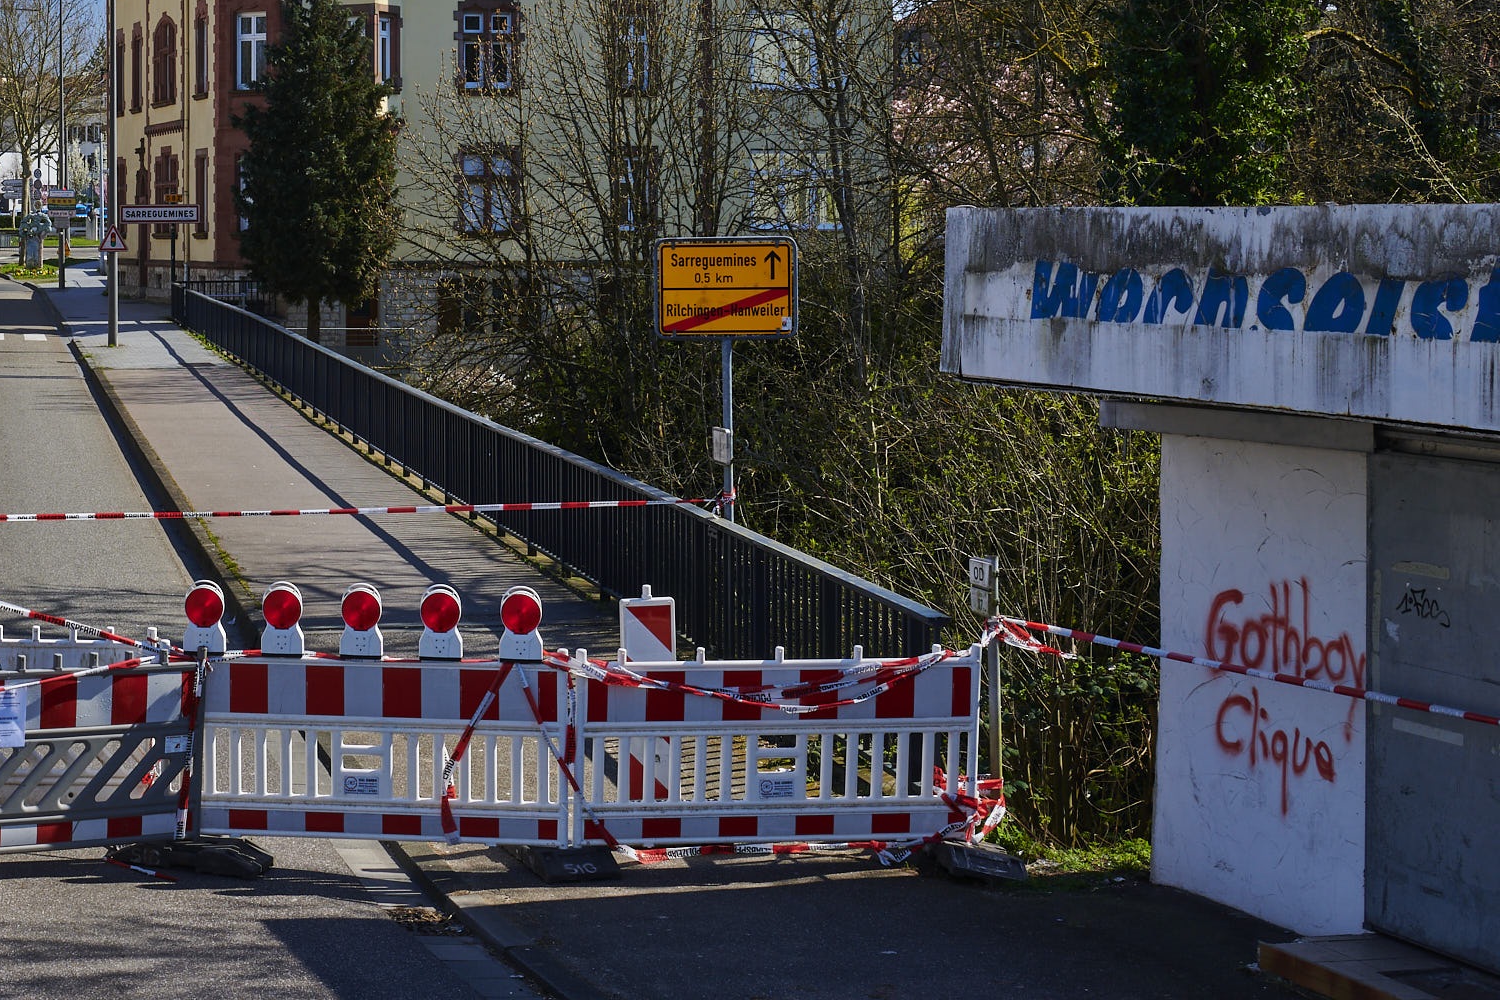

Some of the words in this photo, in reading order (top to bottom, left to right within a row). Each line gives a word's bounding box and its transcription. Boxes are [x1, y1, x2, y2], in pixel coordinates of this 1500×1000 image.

[125, 210, 194, 218] SARREGUEMINES
[671, 253, 757, 270] Sarreguemines
[716, 272, 733, 283] km
[666, 303, 785, 319] Rilchingen-Hanweiler
